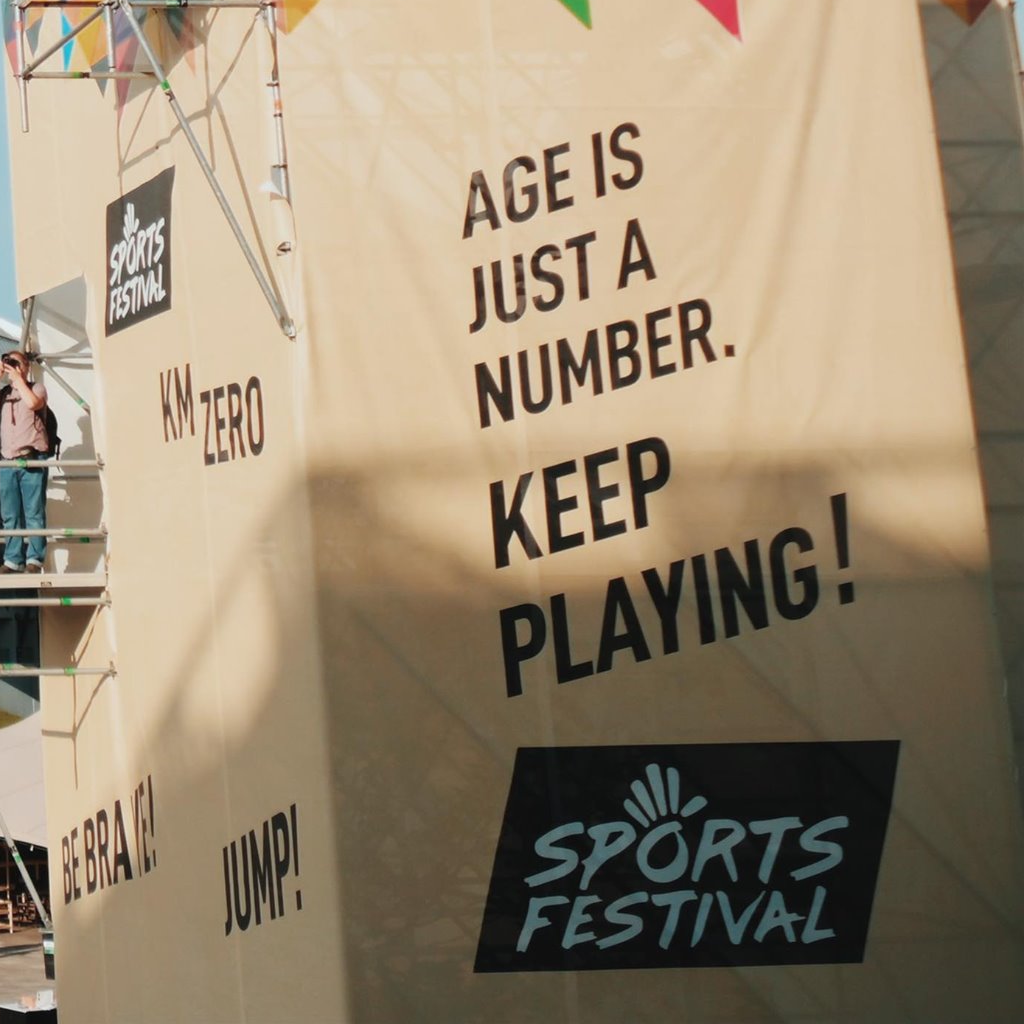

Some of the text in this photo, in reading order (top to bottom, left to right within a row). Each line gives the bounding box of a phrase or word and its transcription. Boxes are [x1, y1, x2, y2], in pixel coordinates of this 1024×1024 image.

[462, 122, 644, 240] AGE IS
[109, 217, 166, 287] SPORTS
[109, 263, 166, 325] FESTIVAL
[469, 217, 657, 334] JUST A
[160, 363, 195, 443] KM
[474, 297, 736, 429] NUMBER.
[199, 375, 265, 466] ZERO
[489, 437, 671, 570] KEEP
[499, 492, 855, 698] PLAYING!
[61, 827, 81, 905] BE
[222, 803, 302, 937] JUMP!
[523, 815, 850, 891] SPORTS
[516, 885, 837, 953] FESTIVAL
